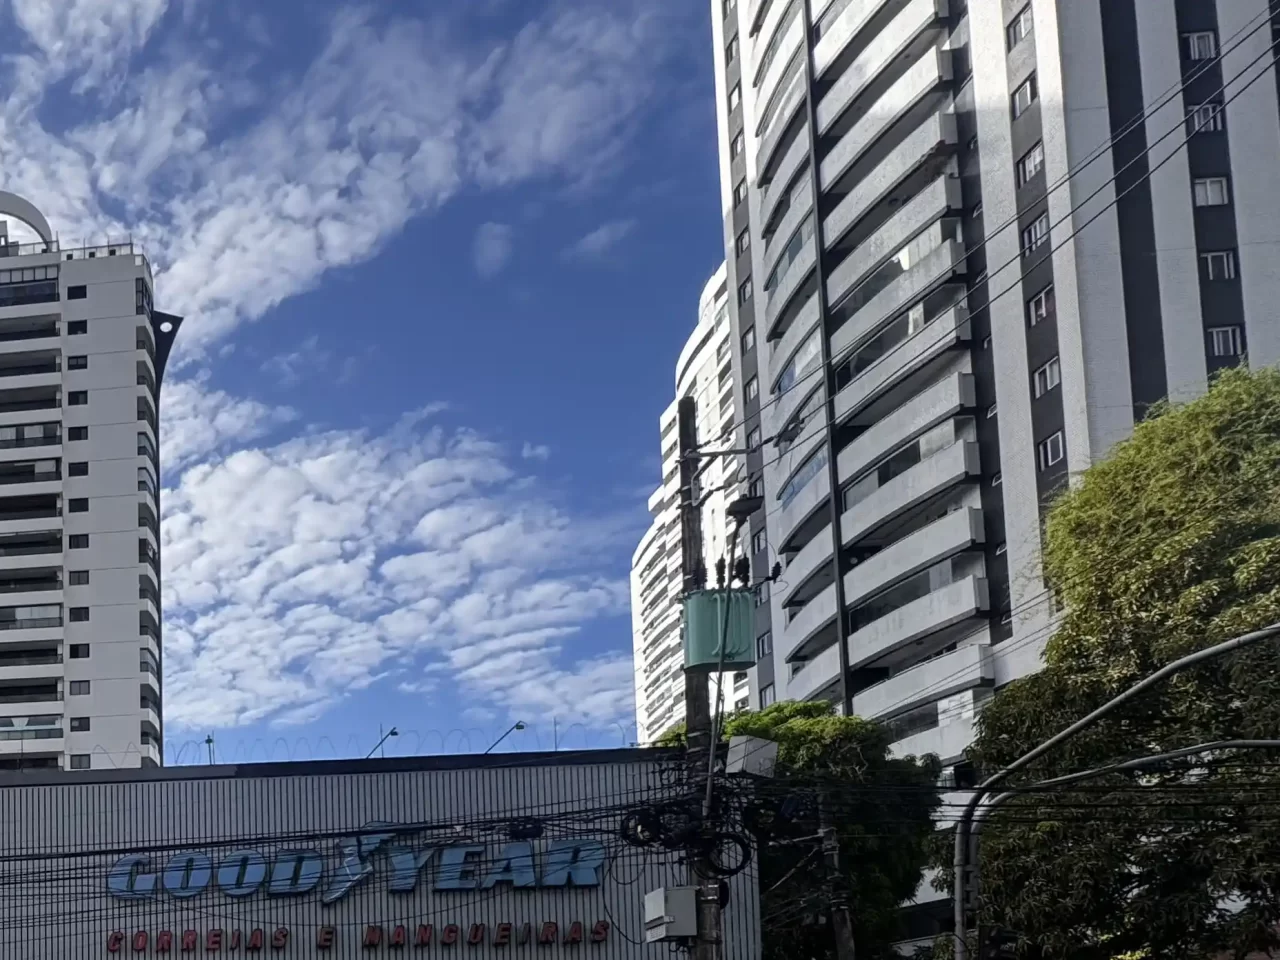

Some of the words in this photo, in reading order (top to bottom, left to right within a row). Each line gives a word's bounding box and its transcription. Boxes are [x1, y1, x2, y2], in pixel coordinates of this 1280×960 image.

[108, 927, 288, 952] CORREIAS
[318, 926, 336, 949] E
[363, 920, 609, 947] MANGUEIRAS
